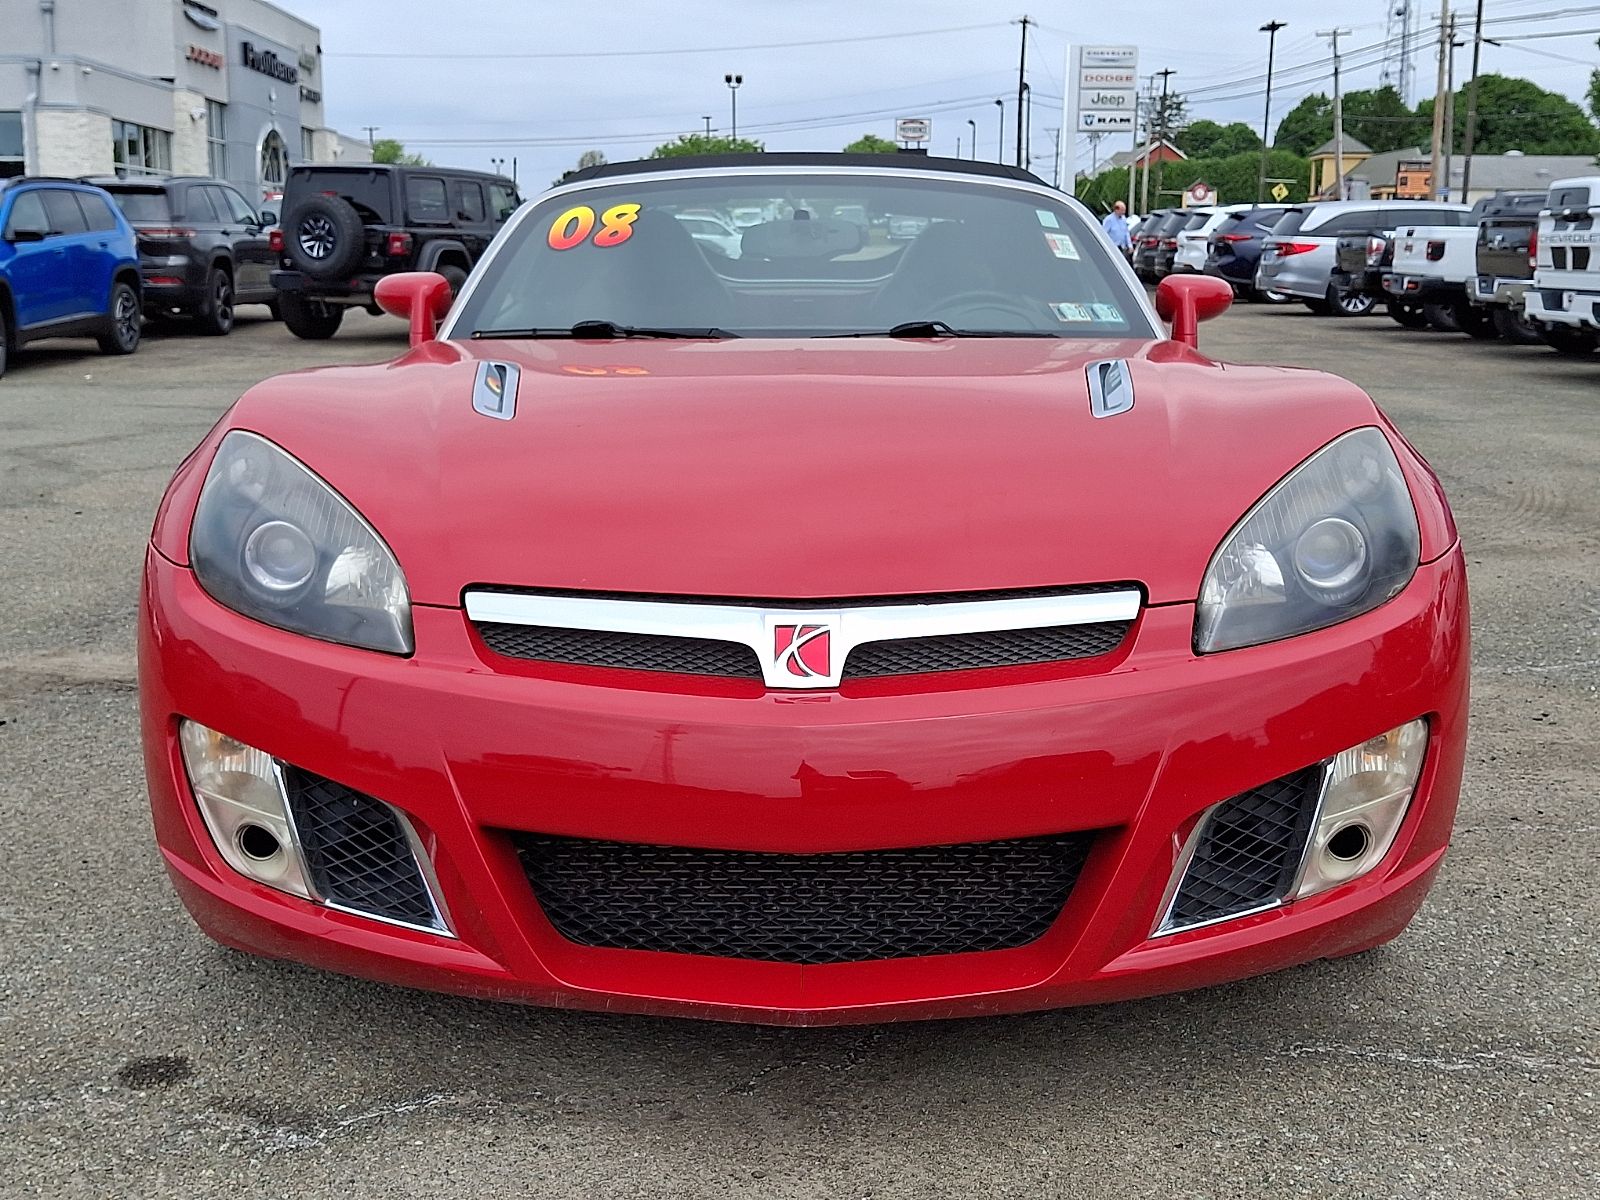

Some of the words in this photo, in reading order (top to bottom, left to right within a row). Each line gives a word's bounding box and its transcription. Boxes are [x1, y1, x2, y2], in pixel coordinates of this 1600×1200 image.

[1085, 74, 1133, 82] DODGE
[1091, 92, 1125, 106] Jeep
[547, 203, 642, 251] 08
